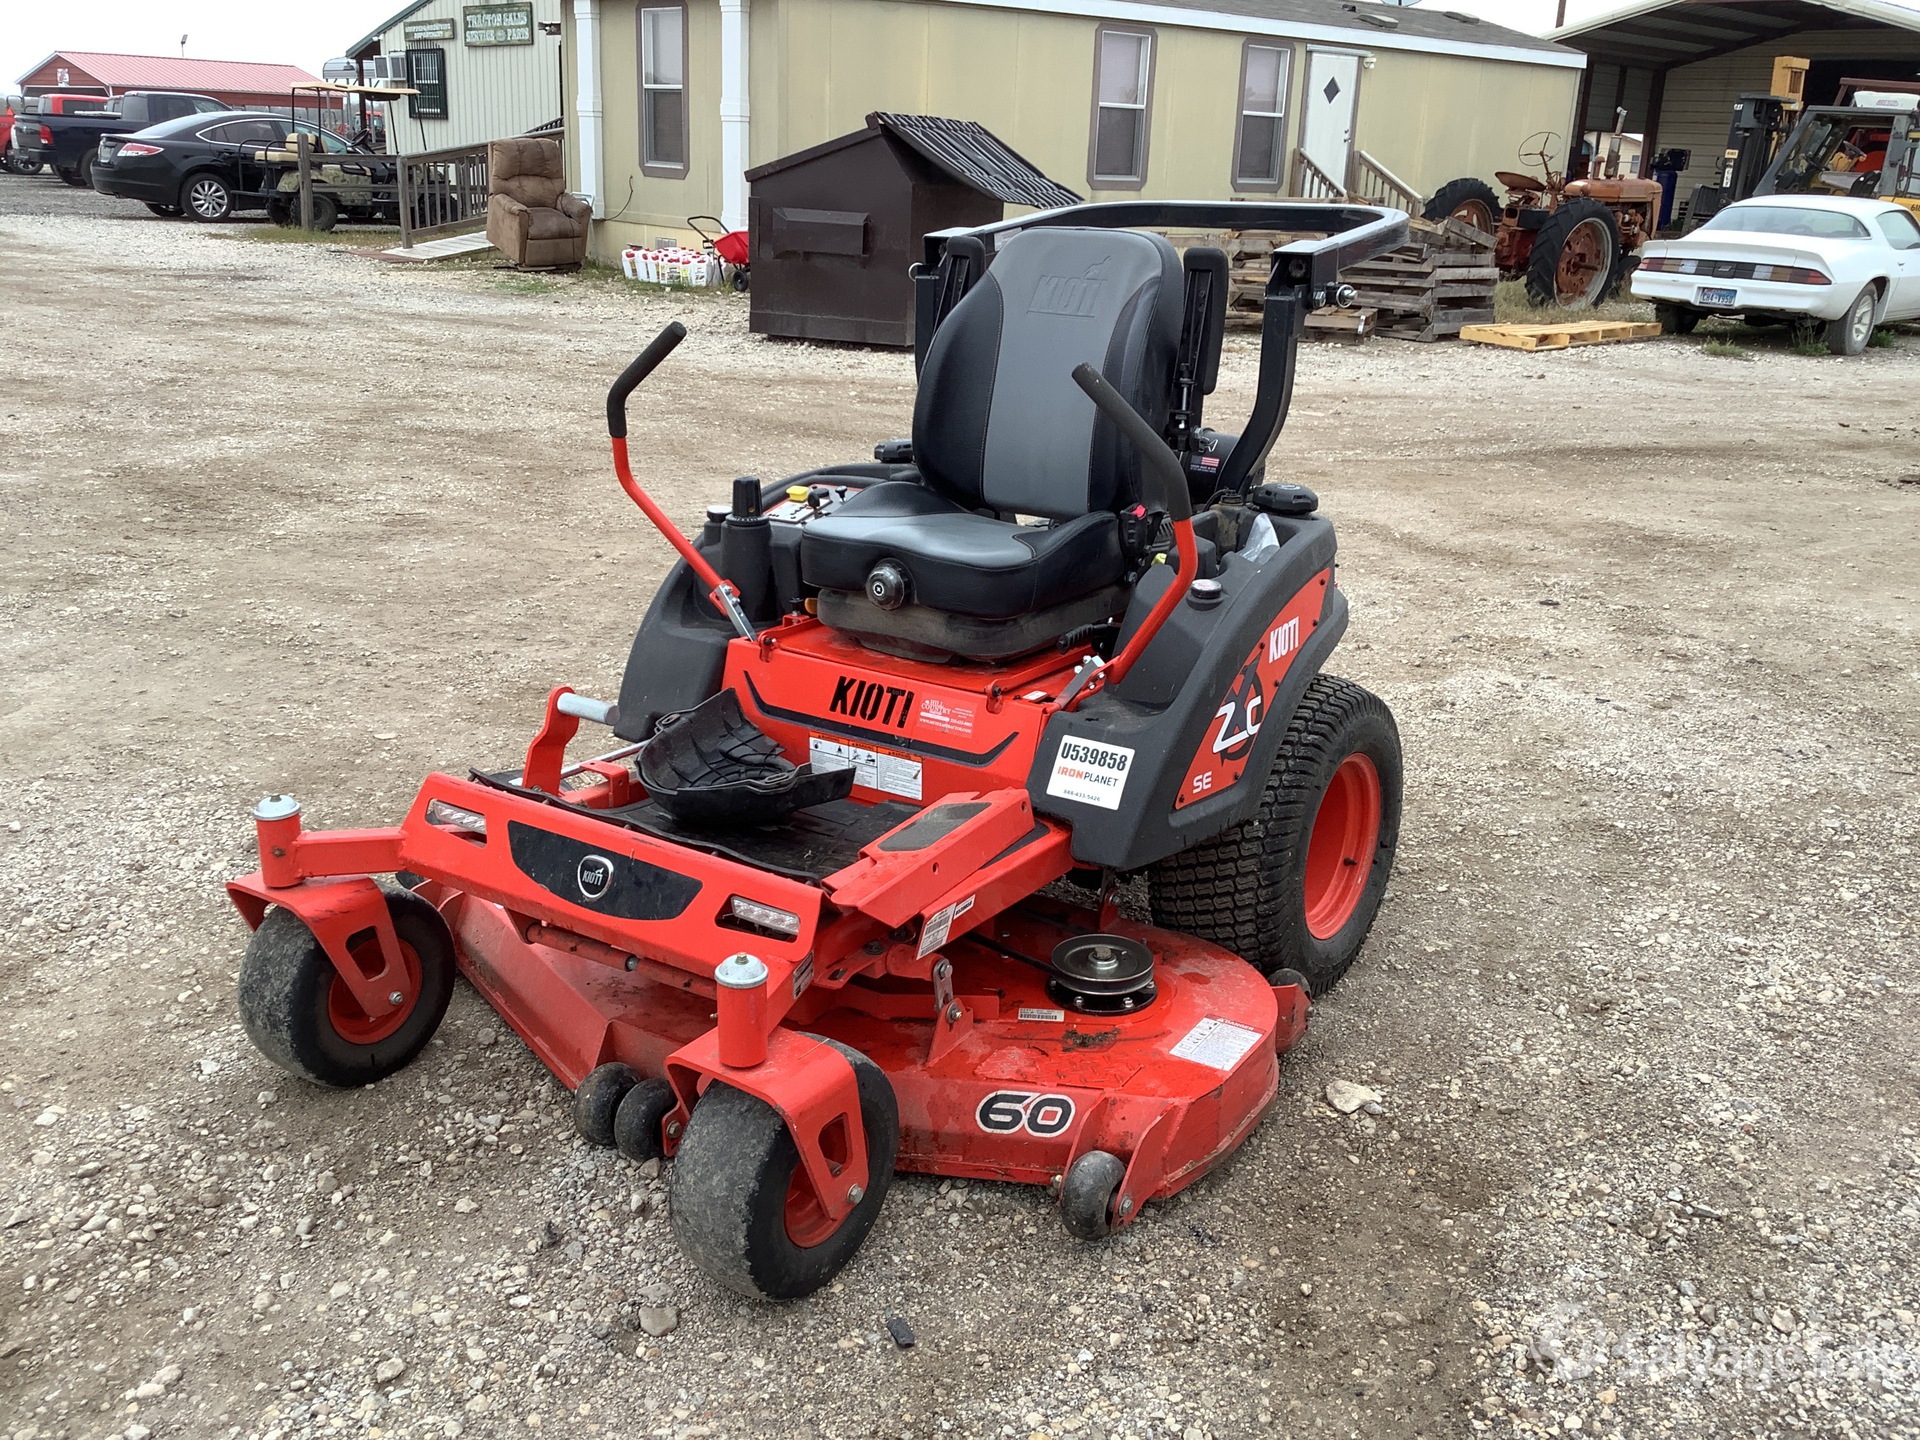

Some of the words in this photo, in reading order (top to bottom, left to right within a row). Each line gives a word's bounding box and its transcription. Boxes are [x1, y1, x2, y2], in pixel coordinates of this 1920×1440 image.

[466, 14, 502, 28] TRACTOR
[503, 12, 527, 26] SALES
[466, 29, 495, 42] SERVICE
[507, 28, 529, 40] PARTS
[1027, 273, 1109, 317] KIOTI
[1268, 615, 1300, 664] KIOTI
[829, 675, 915, 729] KIOTI
[921, 702, 952, 714] COUNTRY
[1061, 742, 1128, 771] U539858
[1192, 771, 1213, 794] SE
[582, 870, 603, 886] KIOTI
[1225, 1019, 1254, 1031] DANGER
[975, 1089, 1076, 1138] 60
